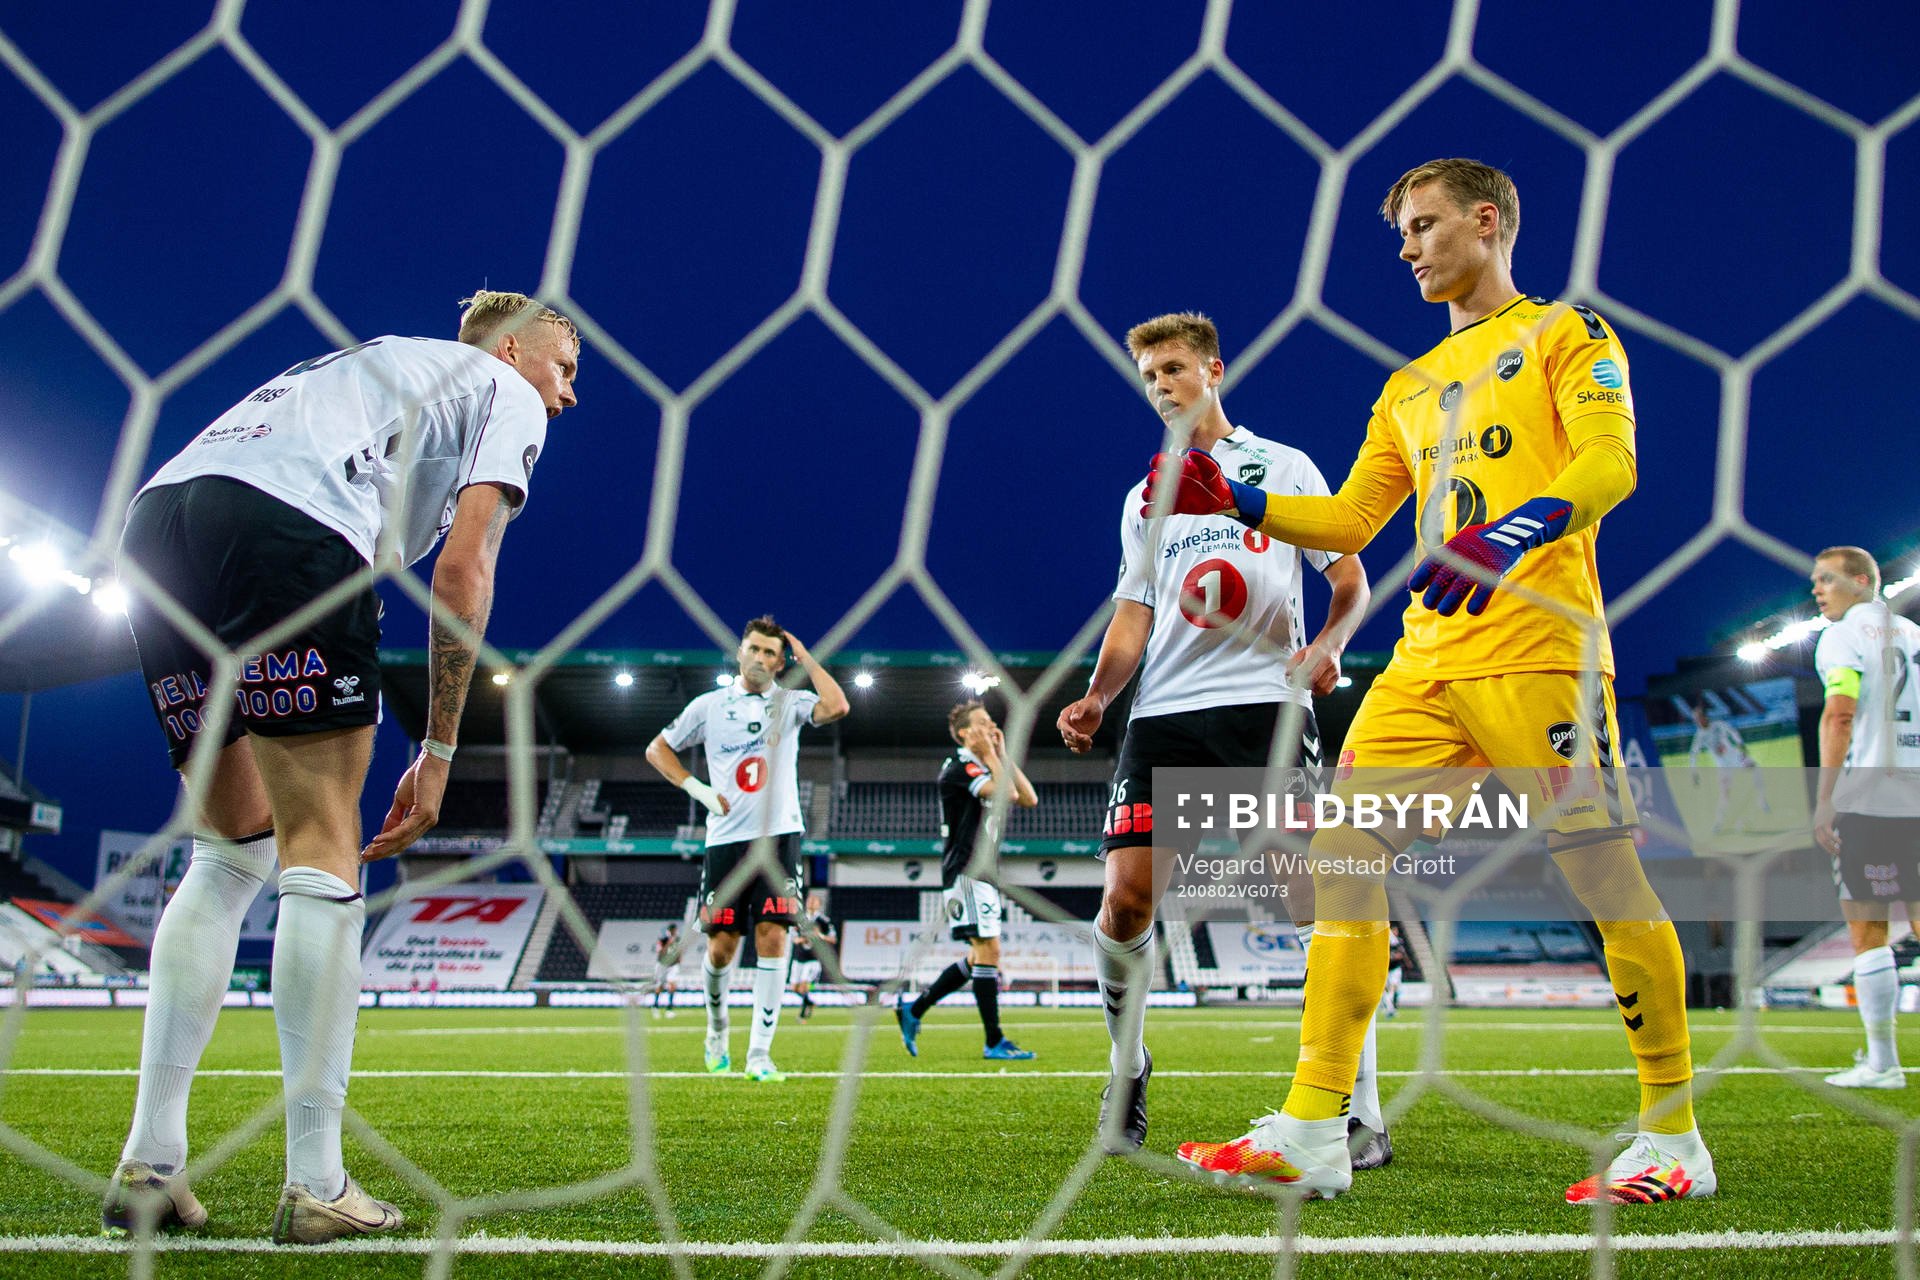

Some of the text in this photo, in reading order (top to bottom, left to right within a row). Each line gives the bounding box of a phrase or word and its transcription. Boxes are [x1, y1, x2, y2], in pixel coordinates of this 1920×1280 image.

[1164, 525, 1241, 559] SpareBank
[1197, 569, 1222, 617] 1
[235, 684, 317, 717] 1000
[332, 692, 365, 706] hummel
[1551, 729, 1577, 743] ODD
[745, 761, 759, 787] 1
[1108, 778, 1129, 808] 26
[1102, 802, 1153, 837] ABB
[1558, 802, 1596, 817] hummel
[411, 896, 529, 924] TA
